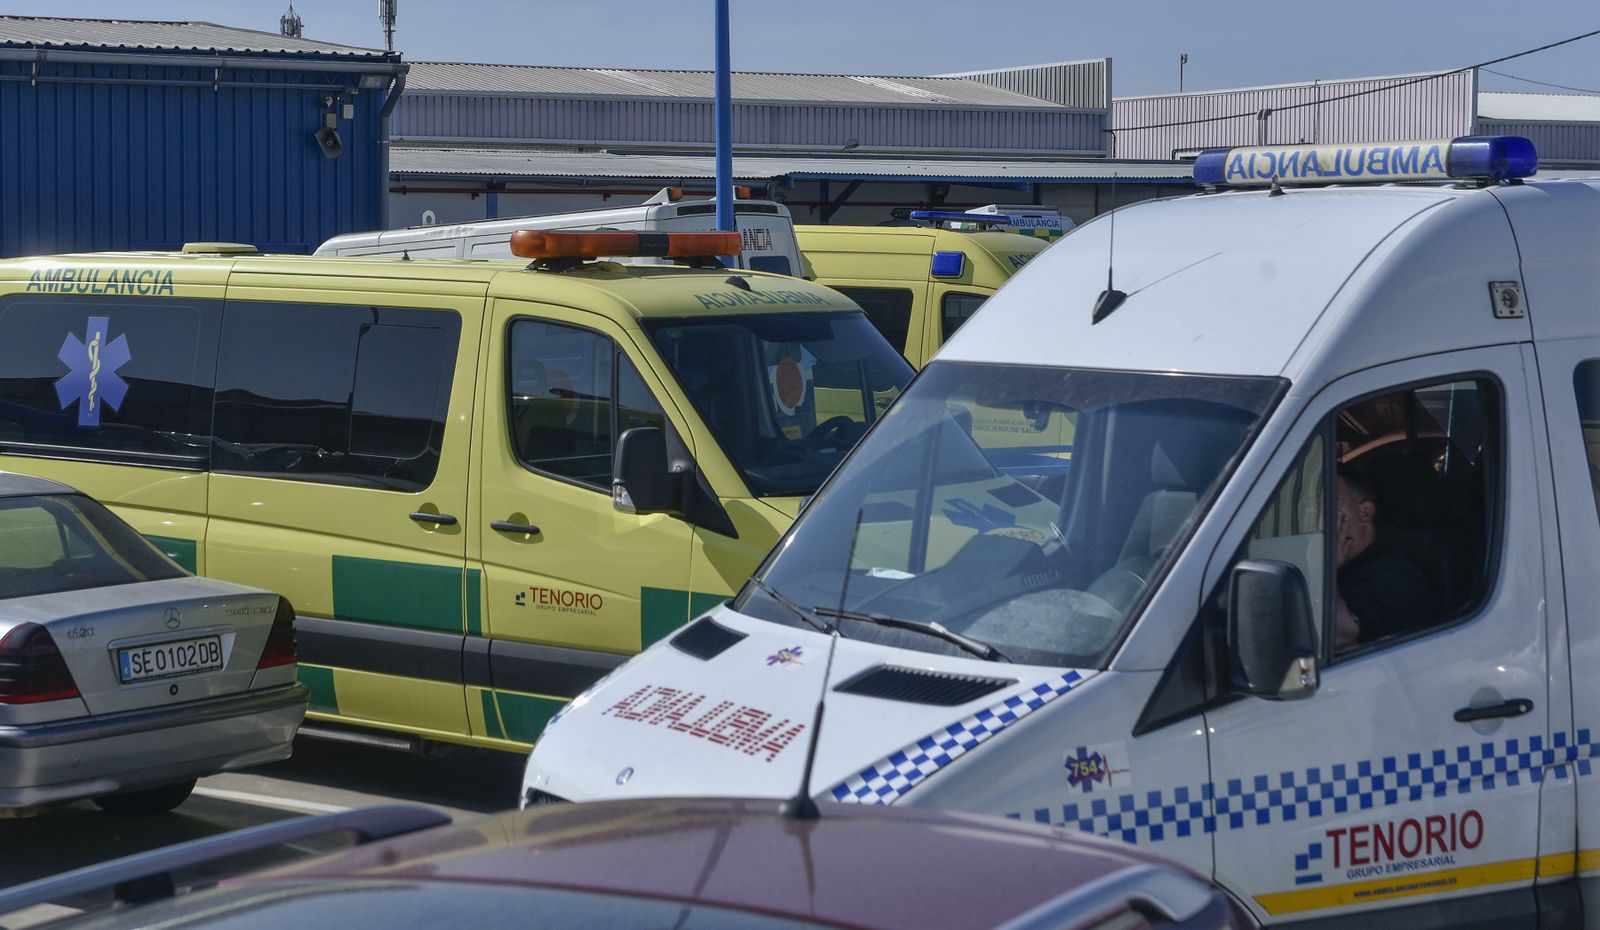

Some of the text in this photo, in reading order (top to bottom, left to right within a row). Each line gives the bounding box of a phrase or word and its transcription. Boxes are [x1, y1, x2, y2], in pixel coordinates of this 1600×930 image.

[1007, 217, 1060, 228] AMBULANCIA
[26, 268, 174, 296] AMBULANCIA
[529, 586, 603, 610] TENORIO
[536, 603, 597, 616] GRUPO EMPRESARIAL
[1071, 759, 1098, 777] 754
[1326, 809, 1484, 868] TENORIO
[1346, 855, 1456, 880] GRUPO EMPRESARIAL
